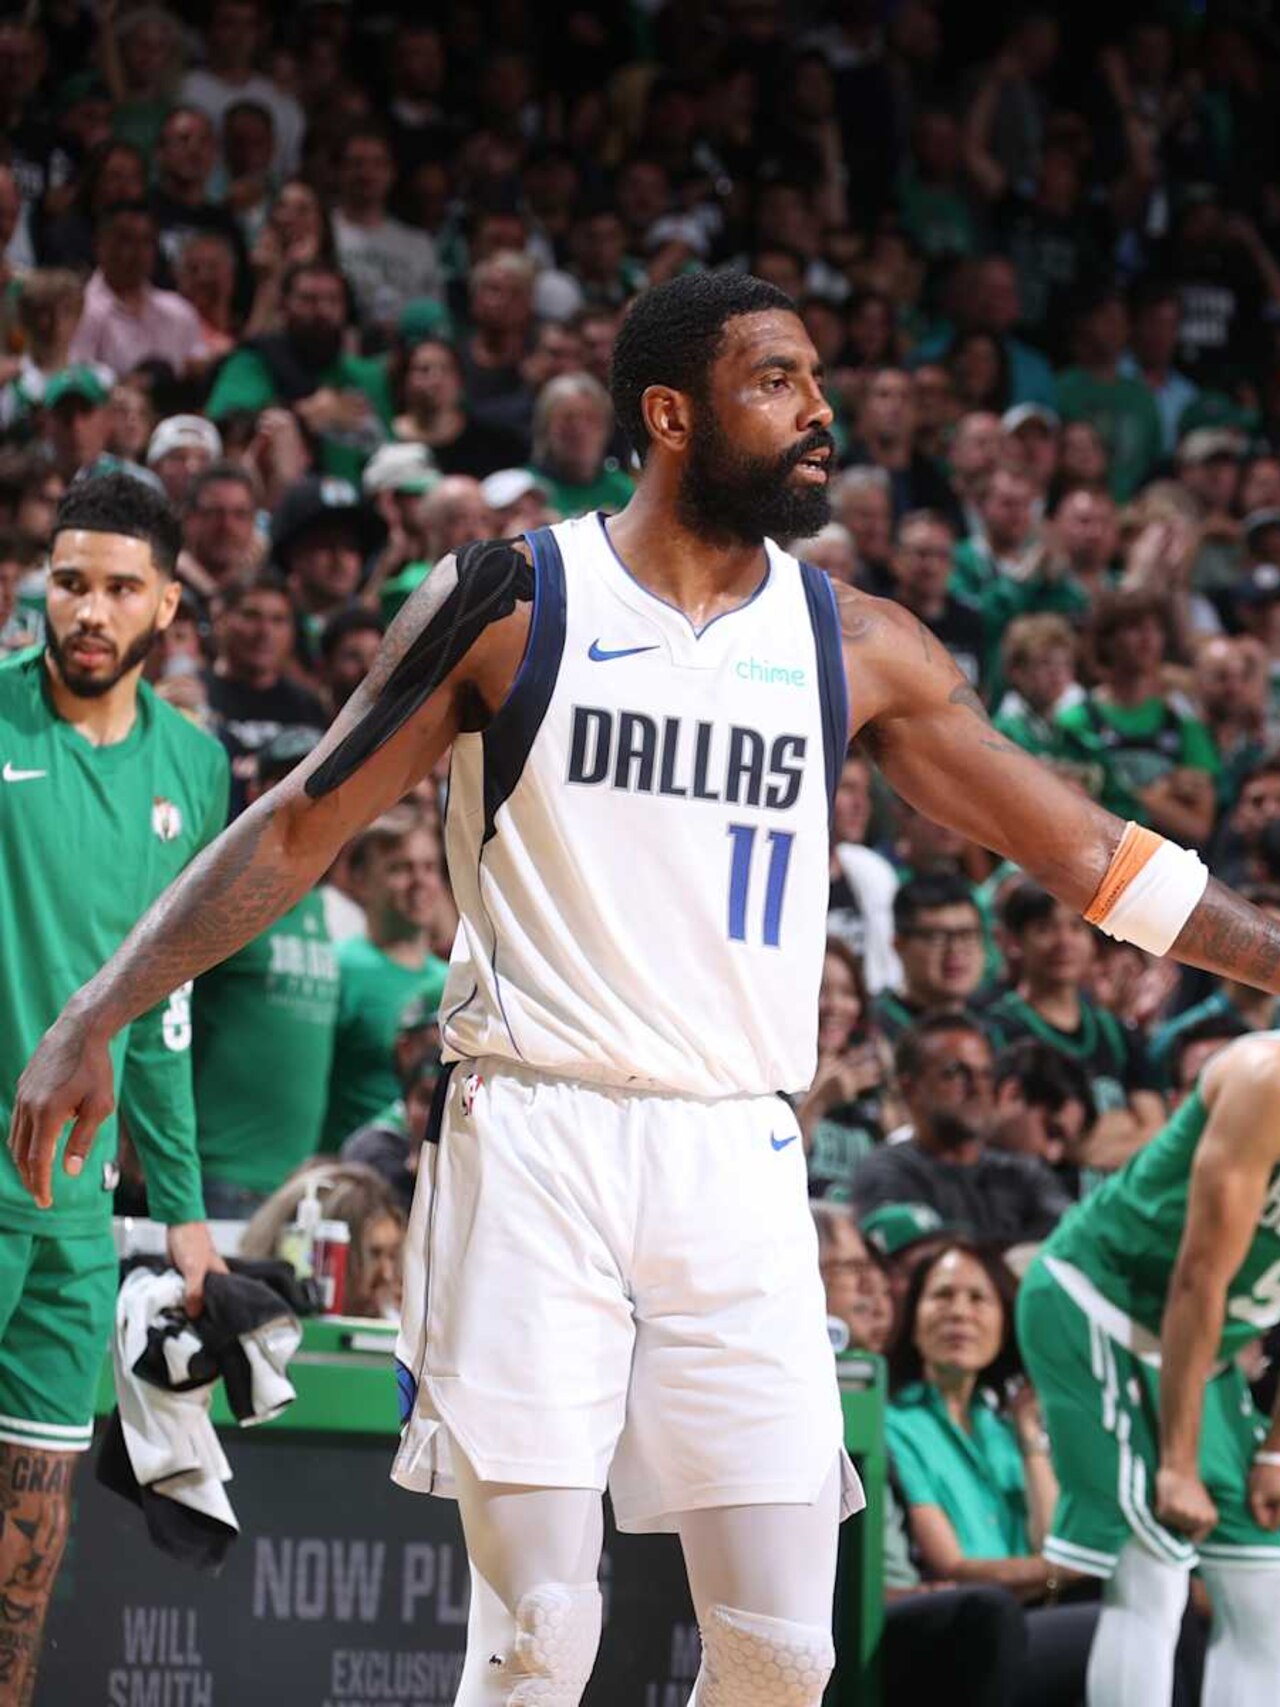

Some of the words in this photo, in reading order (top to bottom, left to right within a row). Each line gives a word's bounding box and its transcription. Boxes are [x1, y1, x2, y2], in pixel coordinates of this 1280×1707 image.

[735, 657, 806, 688] chime
[565, 704, 808, 814] DALLAS
[727, 822, 796, 949] 11
[252, 1536, 385, 1623] NOW
[122, 1605, 202, 1665] WILL
[107, 1669, 214, 1707] SMITH
